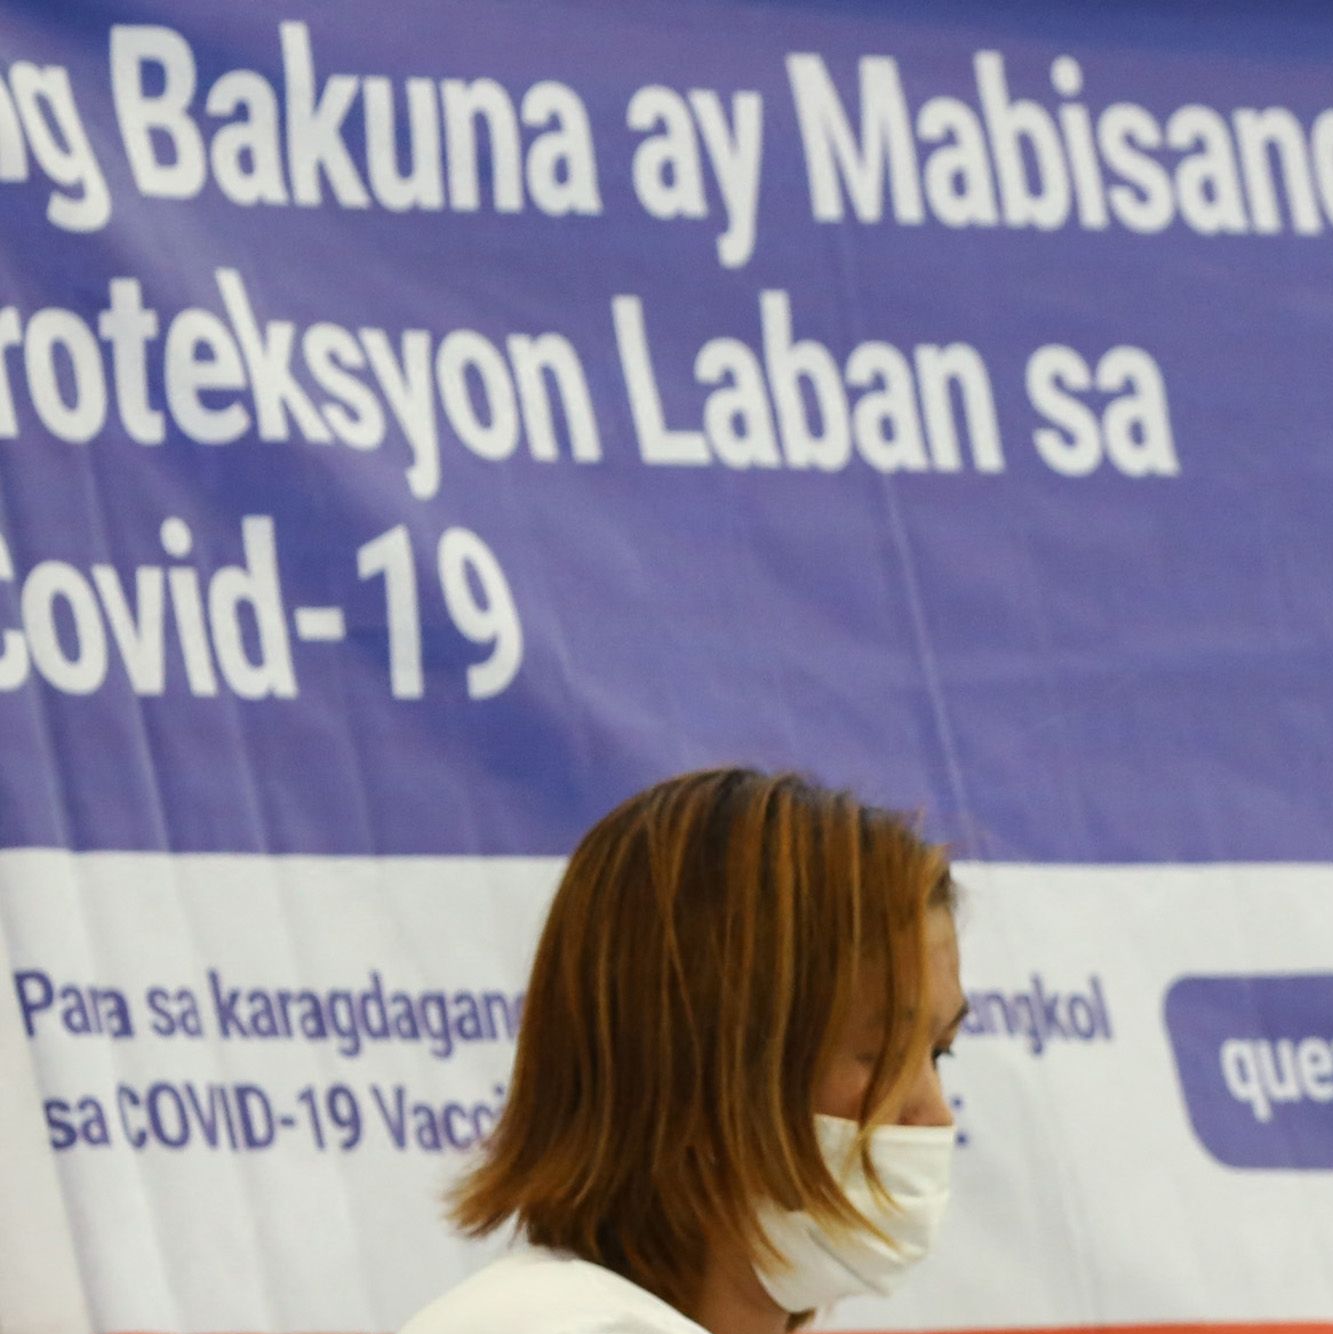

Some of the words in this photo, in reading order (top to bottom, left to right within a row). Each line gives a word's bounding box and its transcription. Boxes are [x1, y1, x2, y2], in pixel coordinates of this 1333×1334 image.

[109, 21, 601, 216] Bakuna
[626, 84, 763, 269] ay
[612, 289, 1004, 474] Laban
[1025, 344, 1181, 477] sa
[13, 969, 134, 1040] Para
[146, 986, 204, 1038] sa
[206, 968, 527, 1058] karagdagan
[44, 1096, 110, 1151] sa
[117, 1080, 364, 1152] COVID-19
